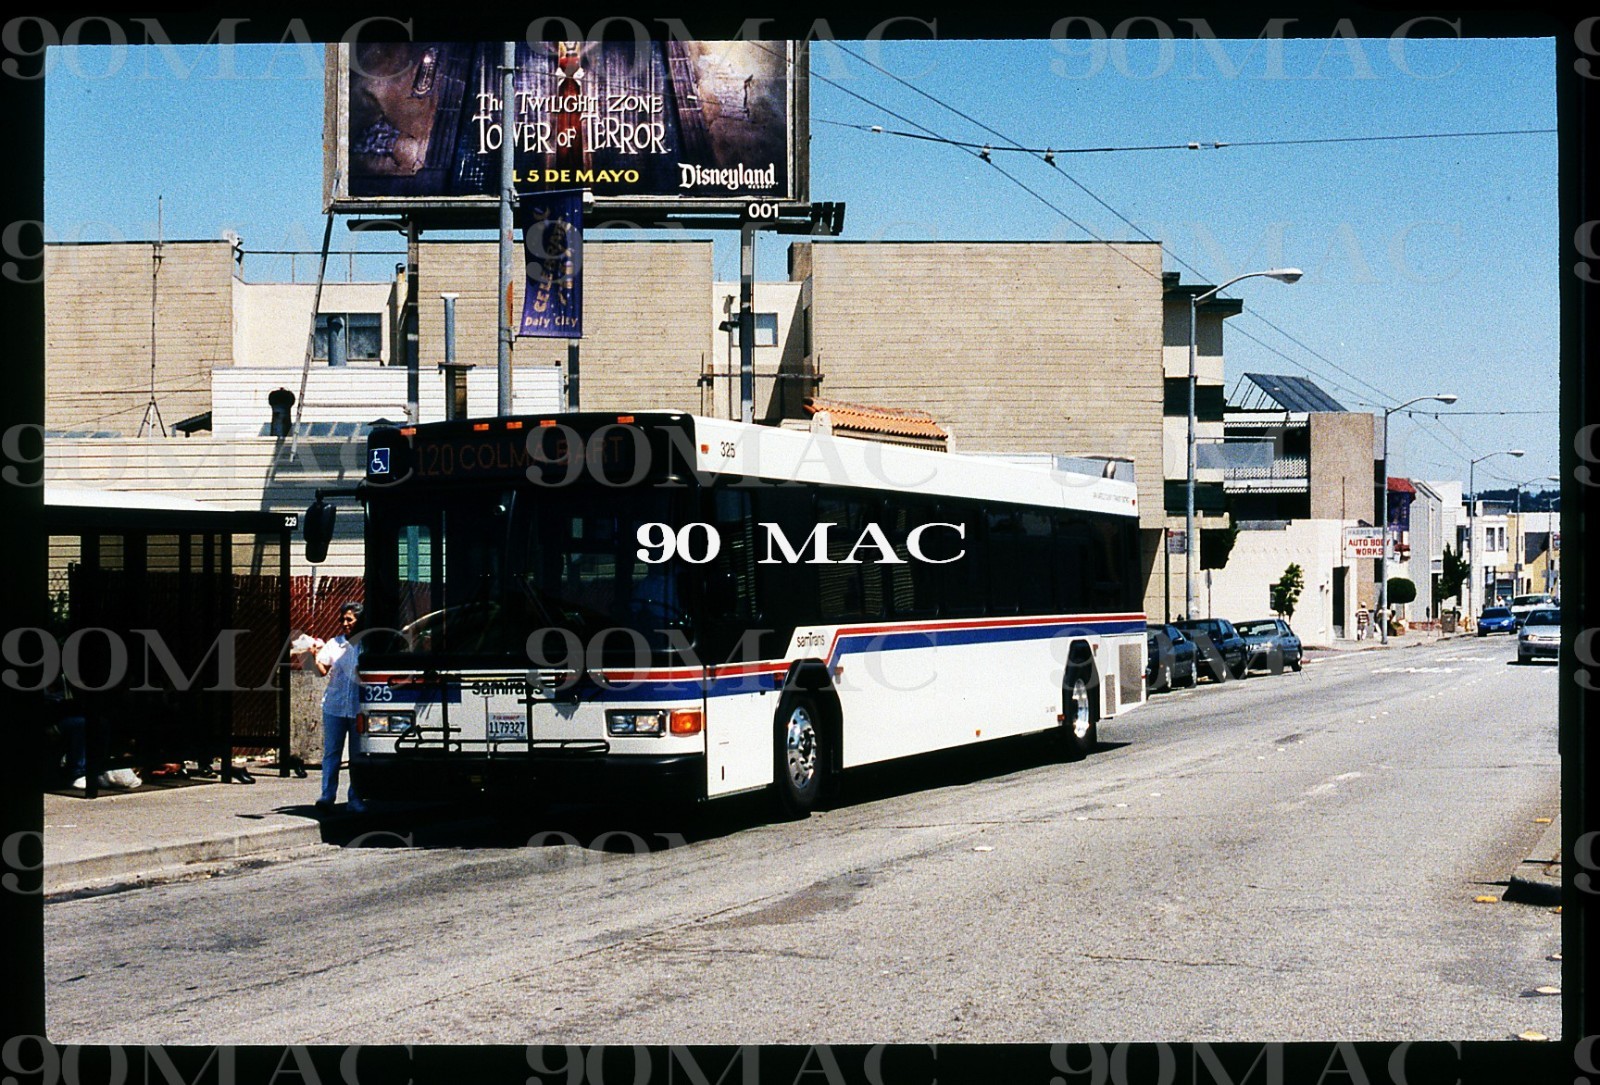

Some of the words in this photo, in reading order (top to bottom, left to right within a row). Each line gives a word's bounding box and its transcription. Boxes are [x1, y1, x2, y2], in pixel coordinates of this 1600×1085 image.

[516, 91, 598, 115] TWILIGHT
[607, 95, 665, 113] ZONE
[580, 113, 669, 154] TERROR
[527, 170, 540, 182] 5
[545, 170, 571, 182] DE
[576, 170, 640, 182] MAYO
[678, 162, 778, 190] Disneyland
[748, 203, 779, 218] 001
[720, 441, 735, 458] 325
[417, 444, 454, 476] 120
[284, 516, 297, 527] 229
[1348, 538, 1369, 546] AUTO
[1355, 547, 1384, 556] WORKS
[365, 685, 392, 701] 325
[489, 721, 525, 734] 1179327
